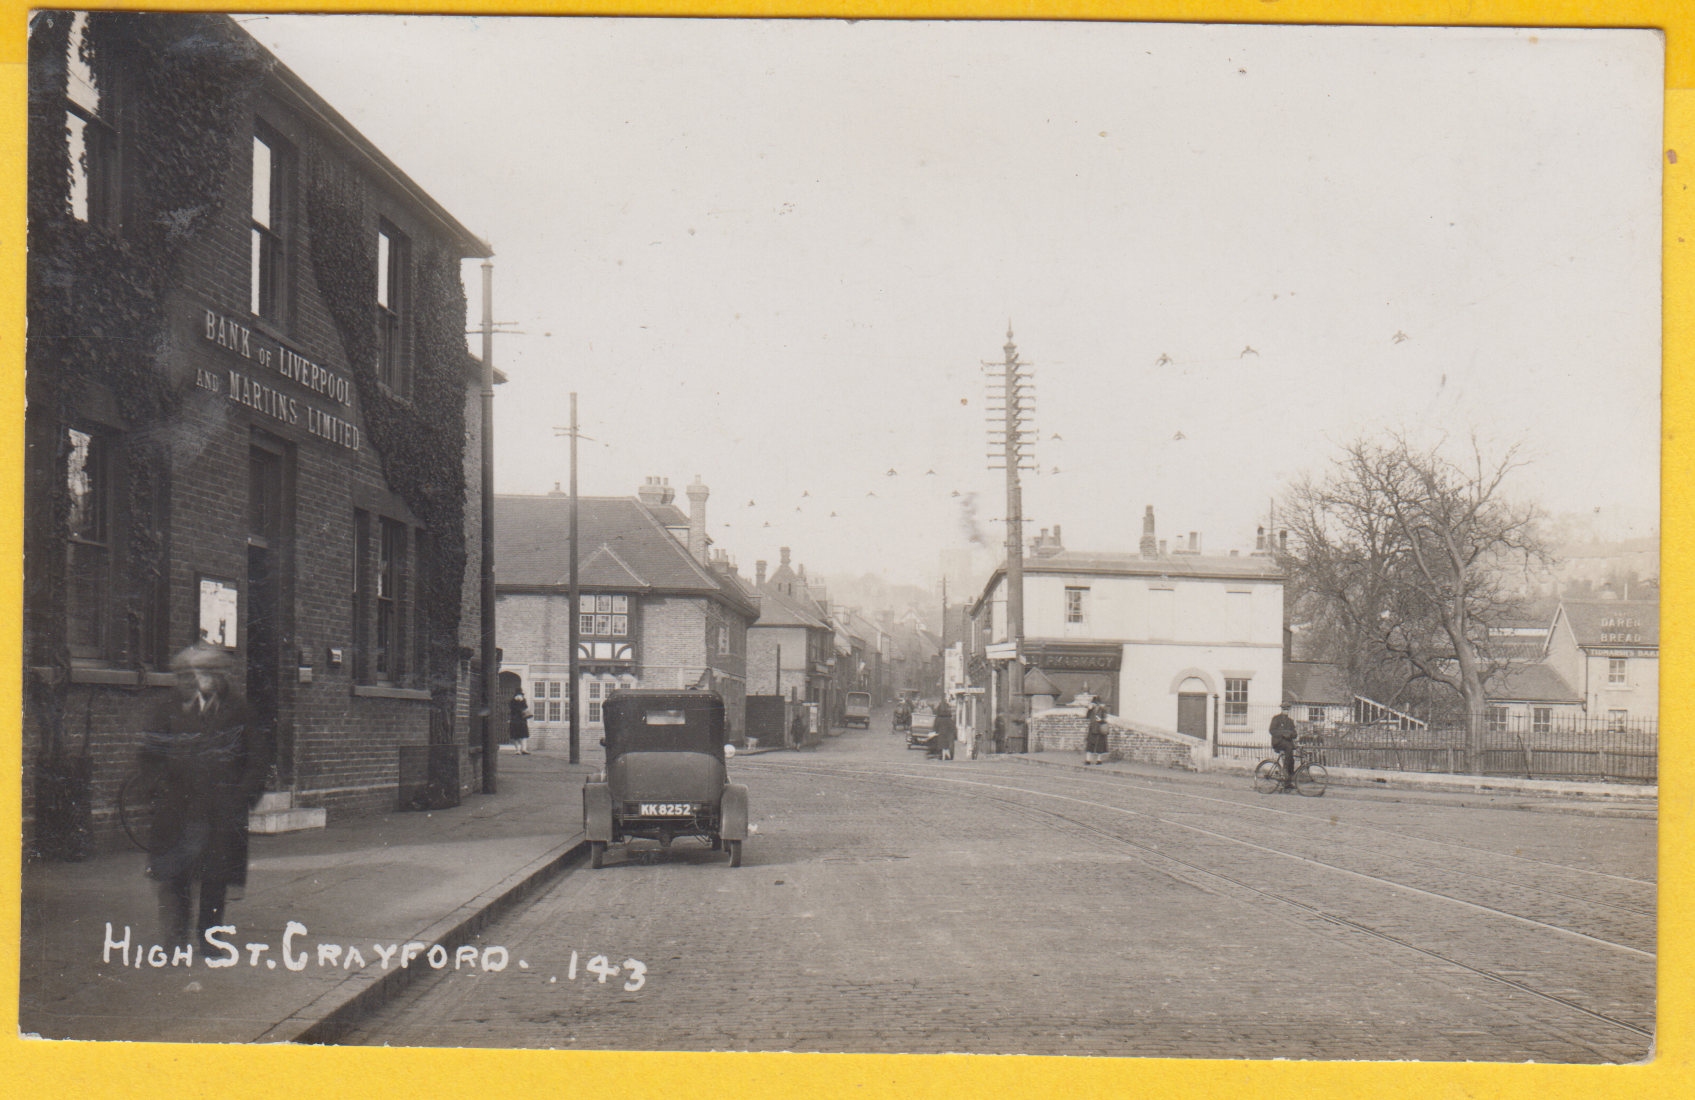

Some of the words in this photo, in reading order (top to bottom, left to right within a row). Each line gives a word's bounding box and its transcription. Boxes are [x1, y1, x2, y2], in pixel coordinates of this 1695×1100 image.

[206, 309, 250, 358] BANK
[259, 348, 272, 368] OF
[279, 346, 351, 407] LIVERPOOL
[196, 368, 219, 392] AND
[229, 370, 298, 425] MARTINS
[307, 406, 360, 451] LIMITED
[1601, 617, 1641, 628] DAREN
[1600, 632, 1641, 643] BREAD
[1047, 655, 1115, 668] PHARMACY
